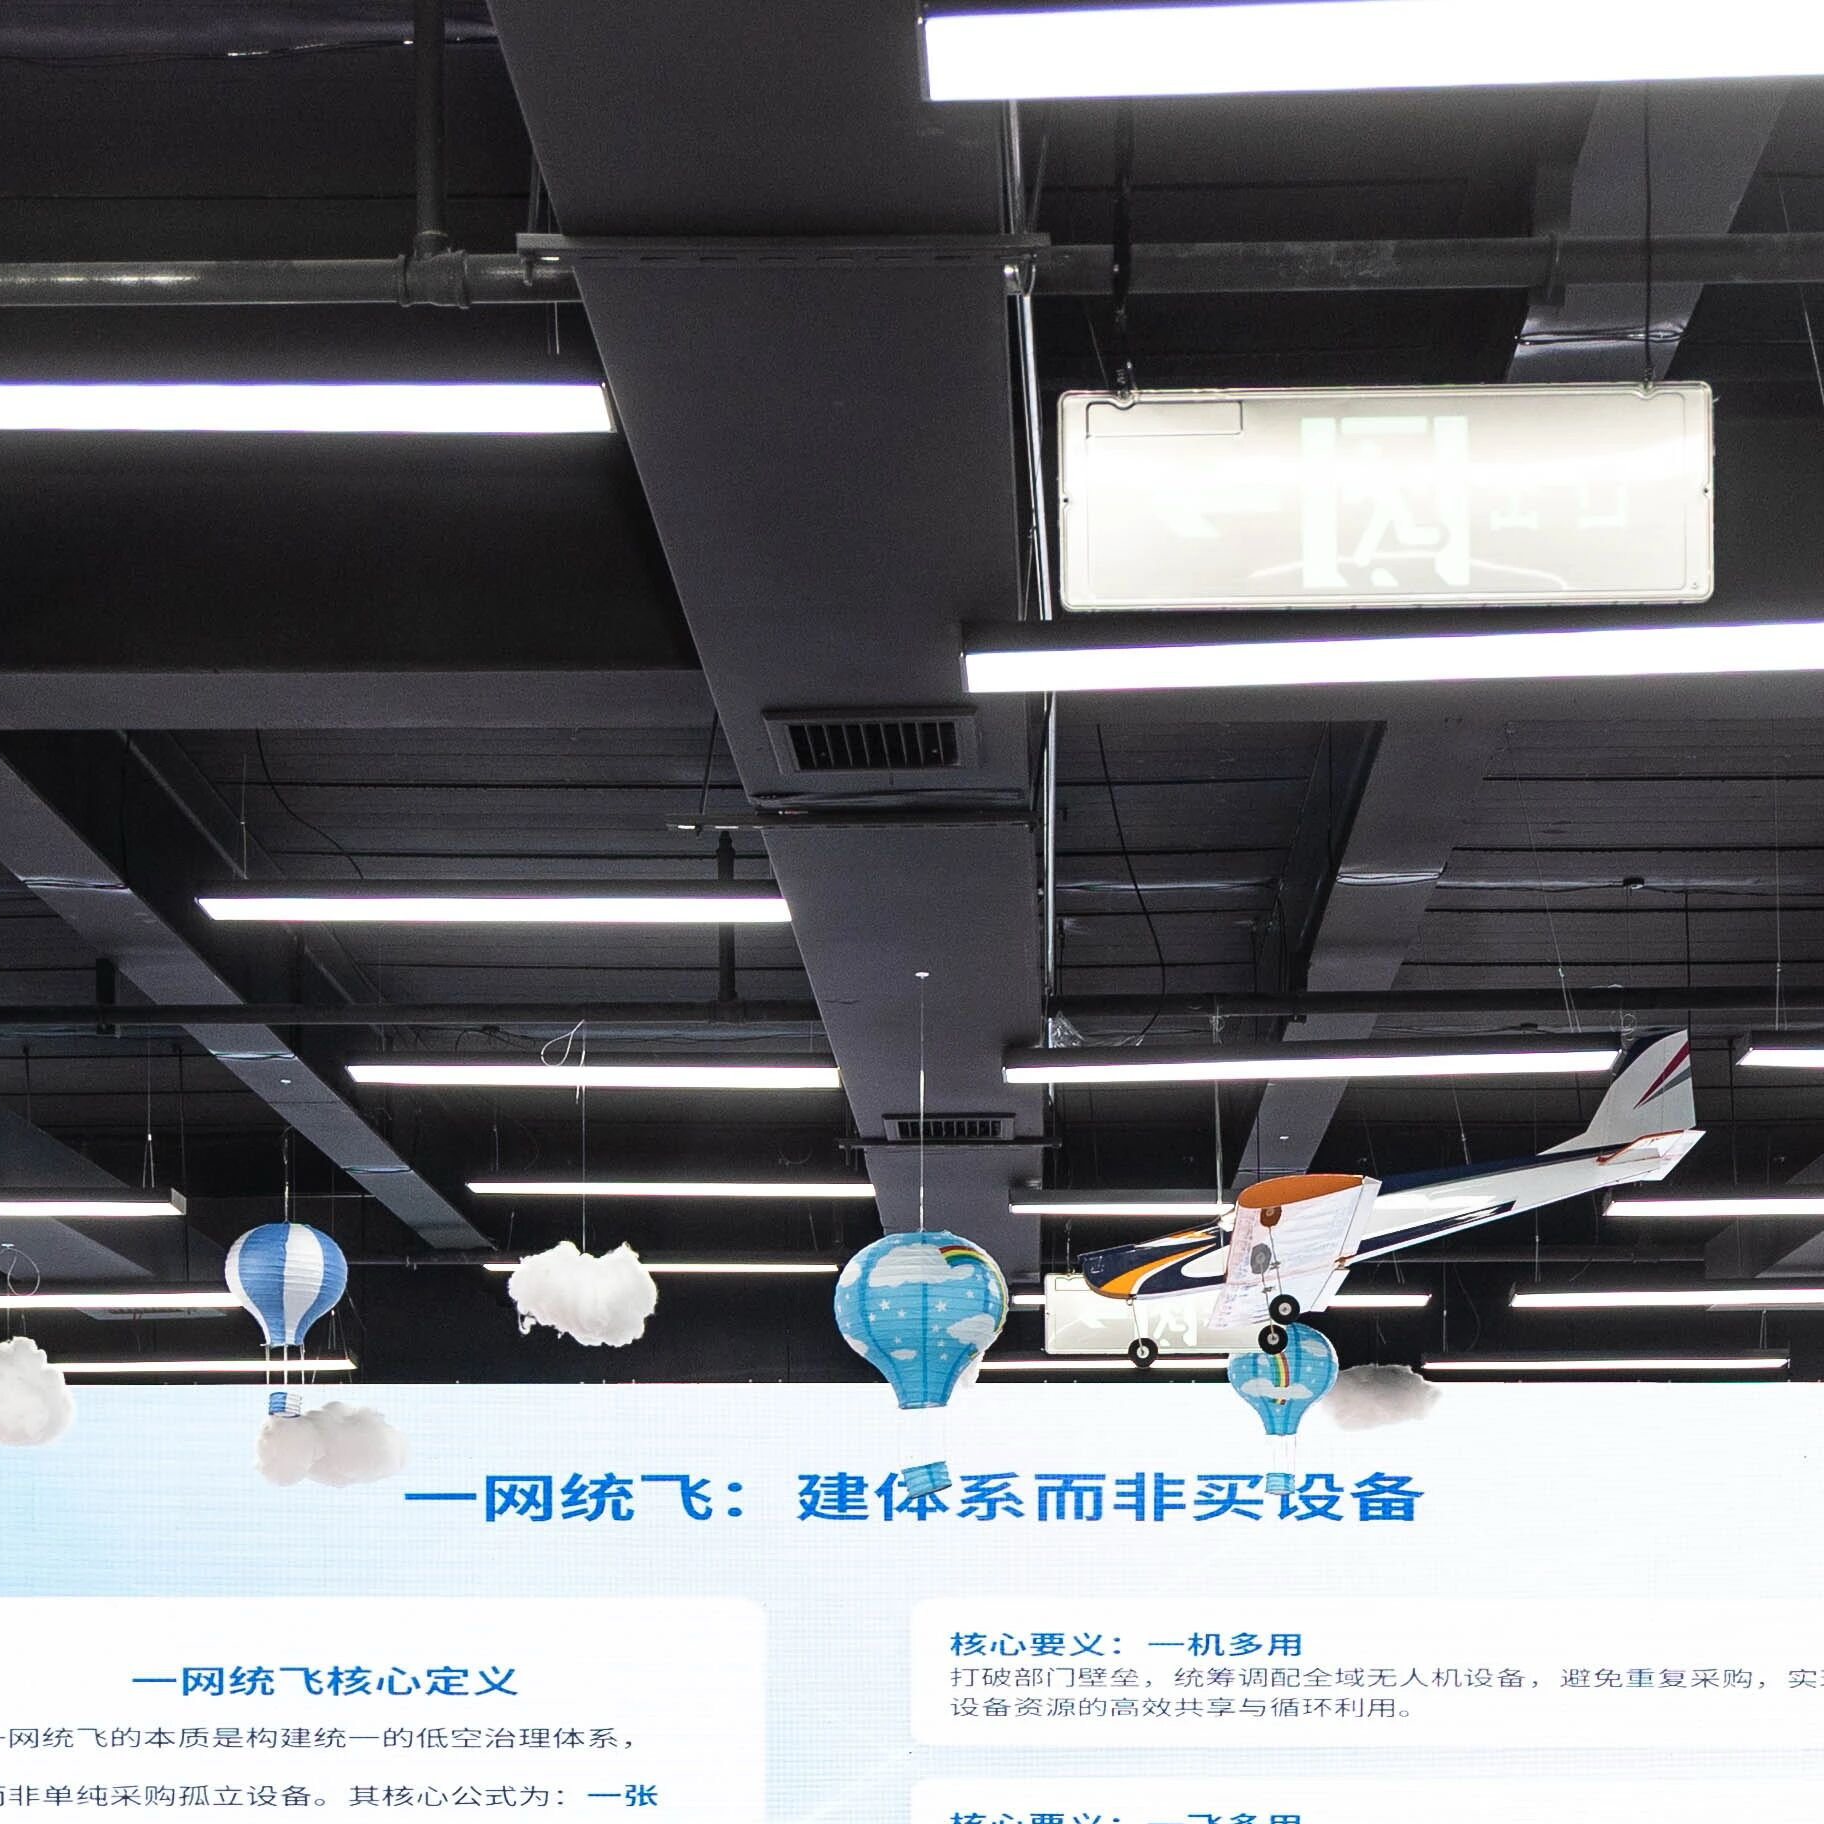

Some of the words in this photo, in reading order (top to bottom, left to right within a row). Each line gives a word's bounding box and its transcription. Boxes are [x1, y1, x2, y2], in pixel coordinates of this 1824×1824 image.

[404, 1472, 1425, 1523] 一网统飞：建体系而非买设备
[950, 1632, 1302, 1657] 核心要义：一机多用
[132, 1665, 518, 1697] 一网统飞核心定义
[951, 1697, 1409, 1718] 设备资源的高效共享与循环利用。
